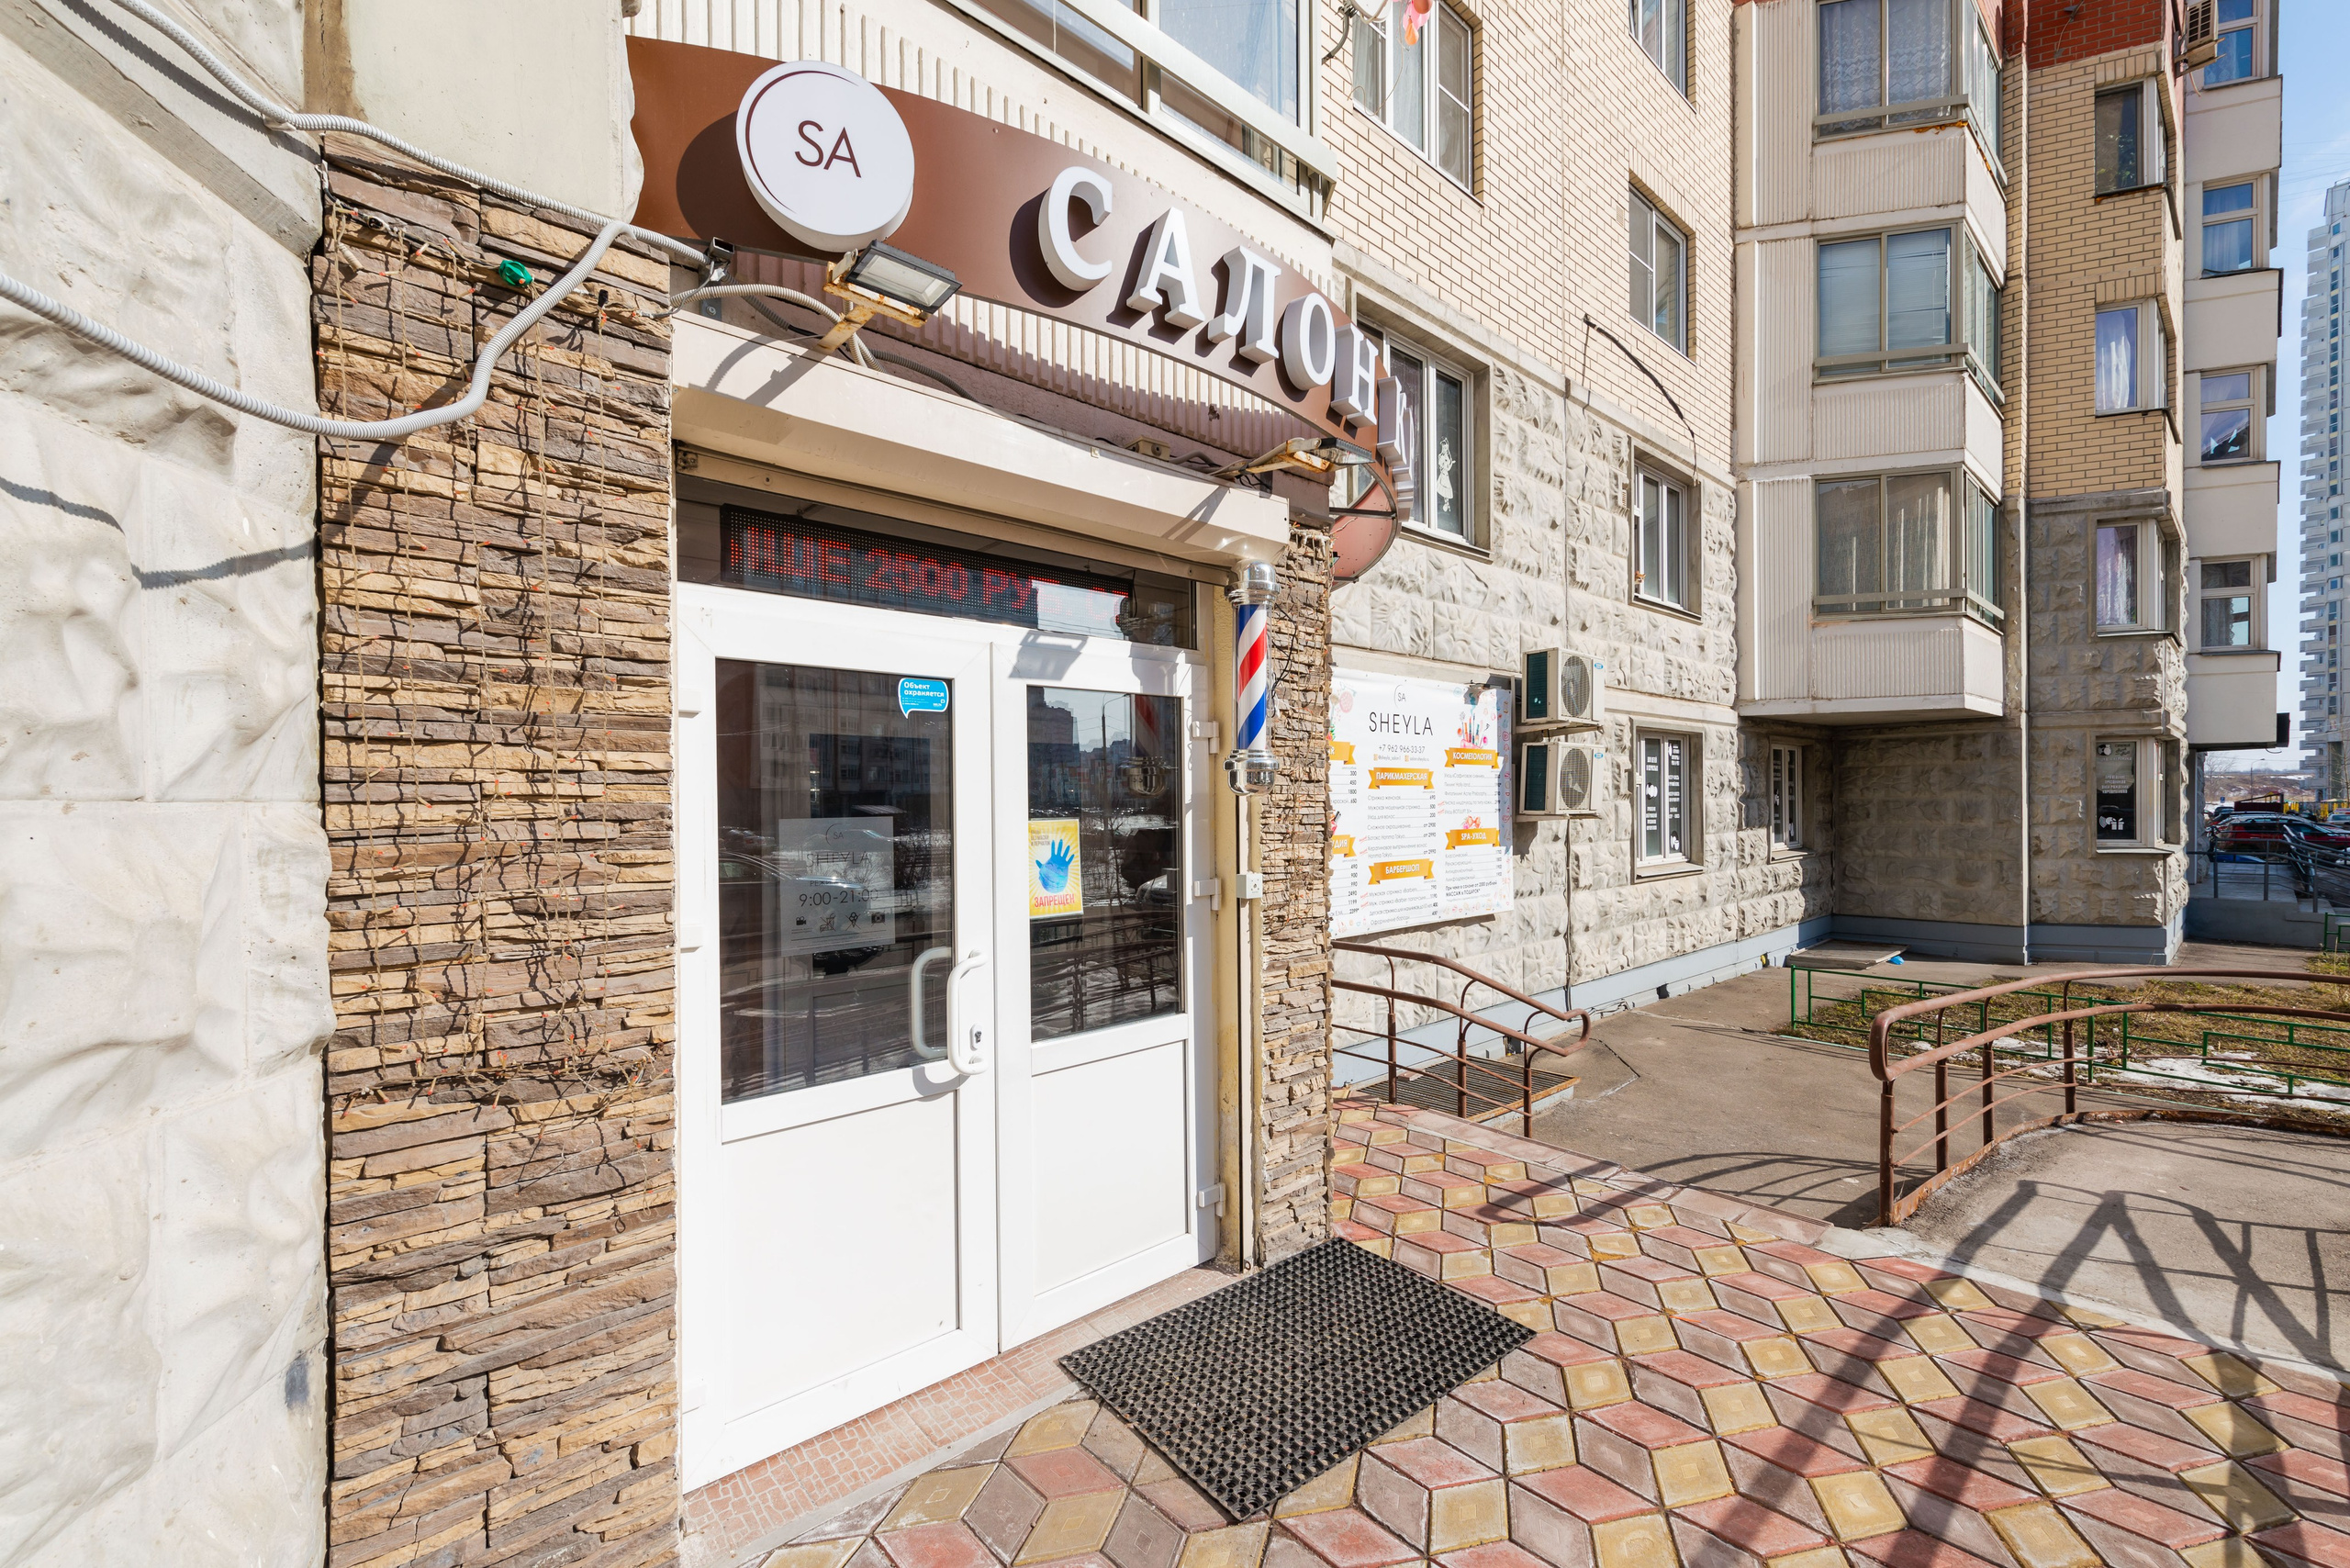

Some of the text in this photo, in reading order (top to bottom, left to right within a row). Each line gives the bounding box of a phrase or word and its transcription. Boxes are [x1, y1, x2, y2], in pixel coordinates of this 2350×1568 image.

[794, 119, 862, 178] SA
[1038, 165, 1379, 426] САЛОН
[865, 548, 968, 600] 2500
[904, 681, 930, 689] Объект
[904, 689, 945, 698] охраняется
[1397, 692, 1406, 702] SA
[1369, 711, 1434, 736] SHEYLA
[1387, 745, 1398, 753] 962
[1399, 745, 1426, 754] 966-33-37
[1453, 752, 1493, 761] КОСМЕТОЛОГИЯ
[1376, 772, 1428, 780] ПАРИКМАХЕРСКАЯ
[833, 831, 845, 840] SA
[1385, 864, 1420, 874] БАРБЕРШОП
[1034, 893, 1076, 908] ЗАПРЕЩЕН
